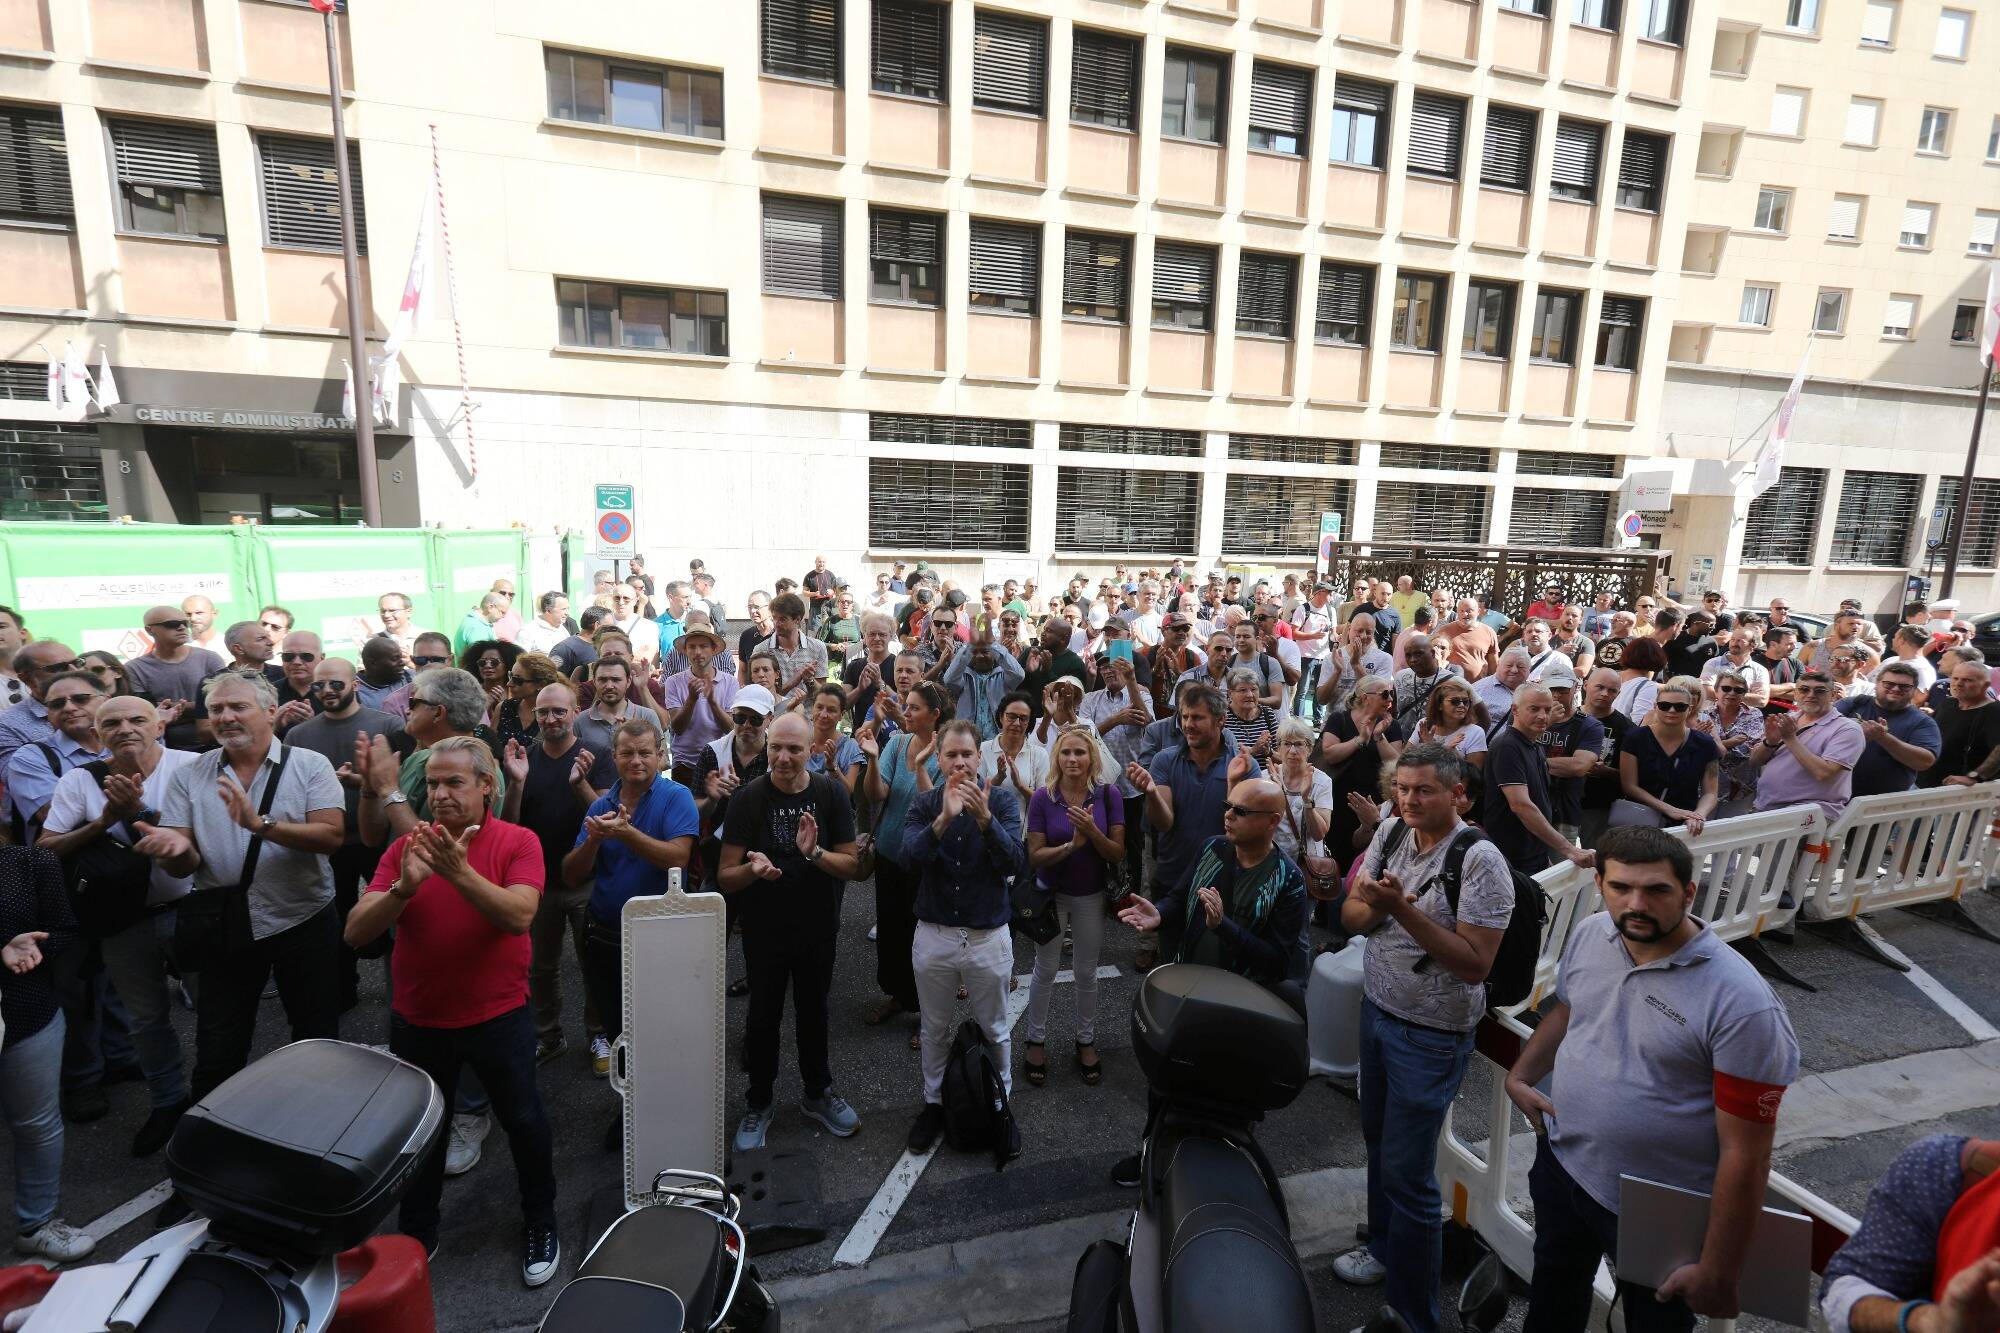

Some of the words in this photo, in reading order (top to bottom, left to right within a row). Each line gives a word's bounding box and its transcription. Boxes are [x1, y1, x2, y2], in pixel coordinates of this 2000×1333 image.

[136, 408, 215, 424] CENTRE
[221, 413, 357, 430] ADMINISTRATI
[119, 460, 131, 474] 8
[392, 468, 404, 484] 8
[1641, 513, 1667, 523] Monaco
[1604, 645, 1617, 659] B
[1646, 994, 1687, 1024] MONTE-CARLO
